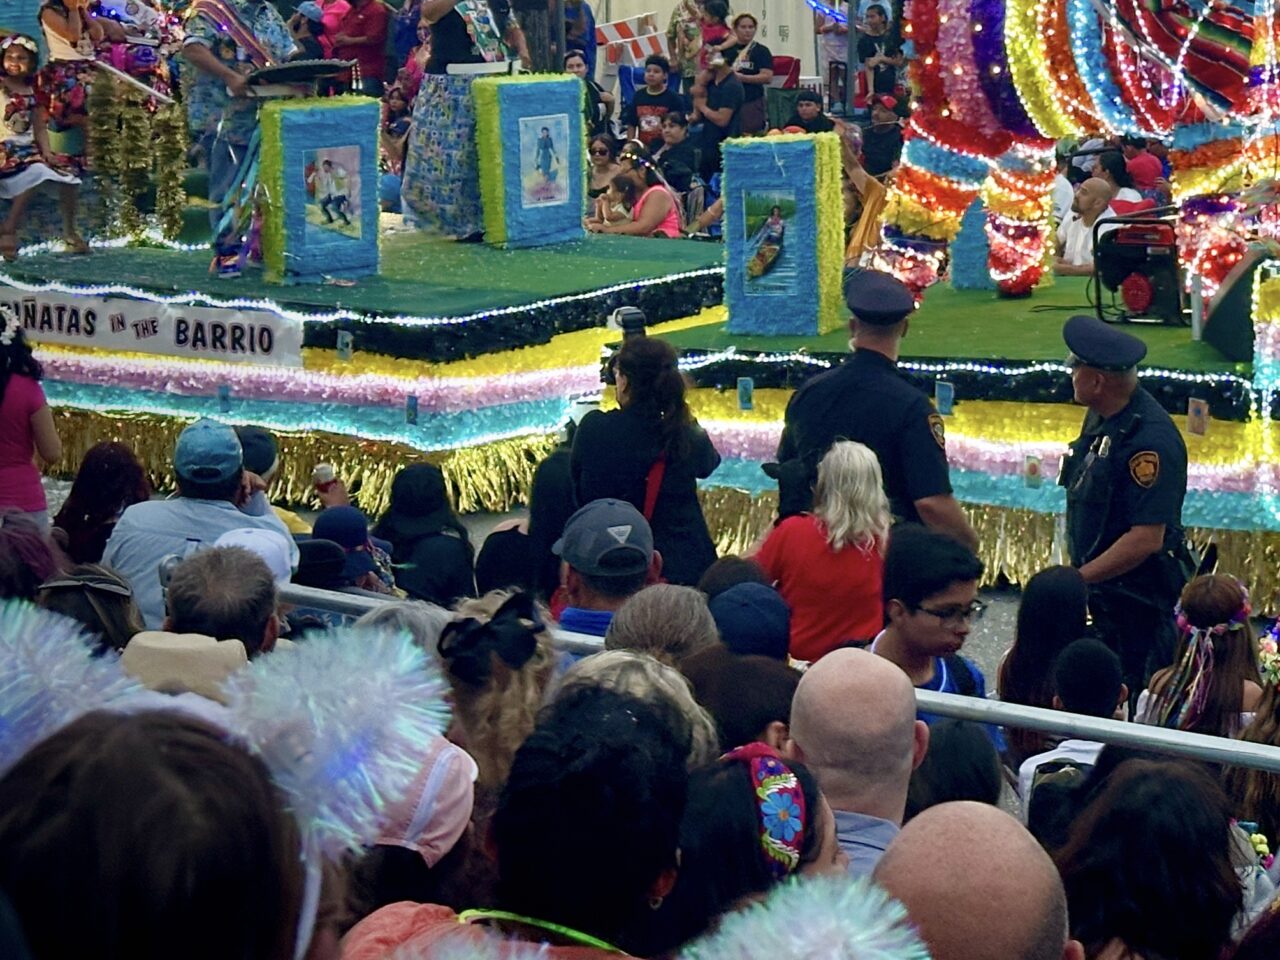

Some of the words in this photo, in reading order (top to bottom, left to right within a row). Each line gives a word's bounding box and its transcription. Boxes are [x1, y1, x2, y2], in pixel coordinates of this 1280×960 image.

[110, 313, 126, 332] IN
[131, 318, 159, 340] THE
[173, 318, 274, 356] BARRIO
